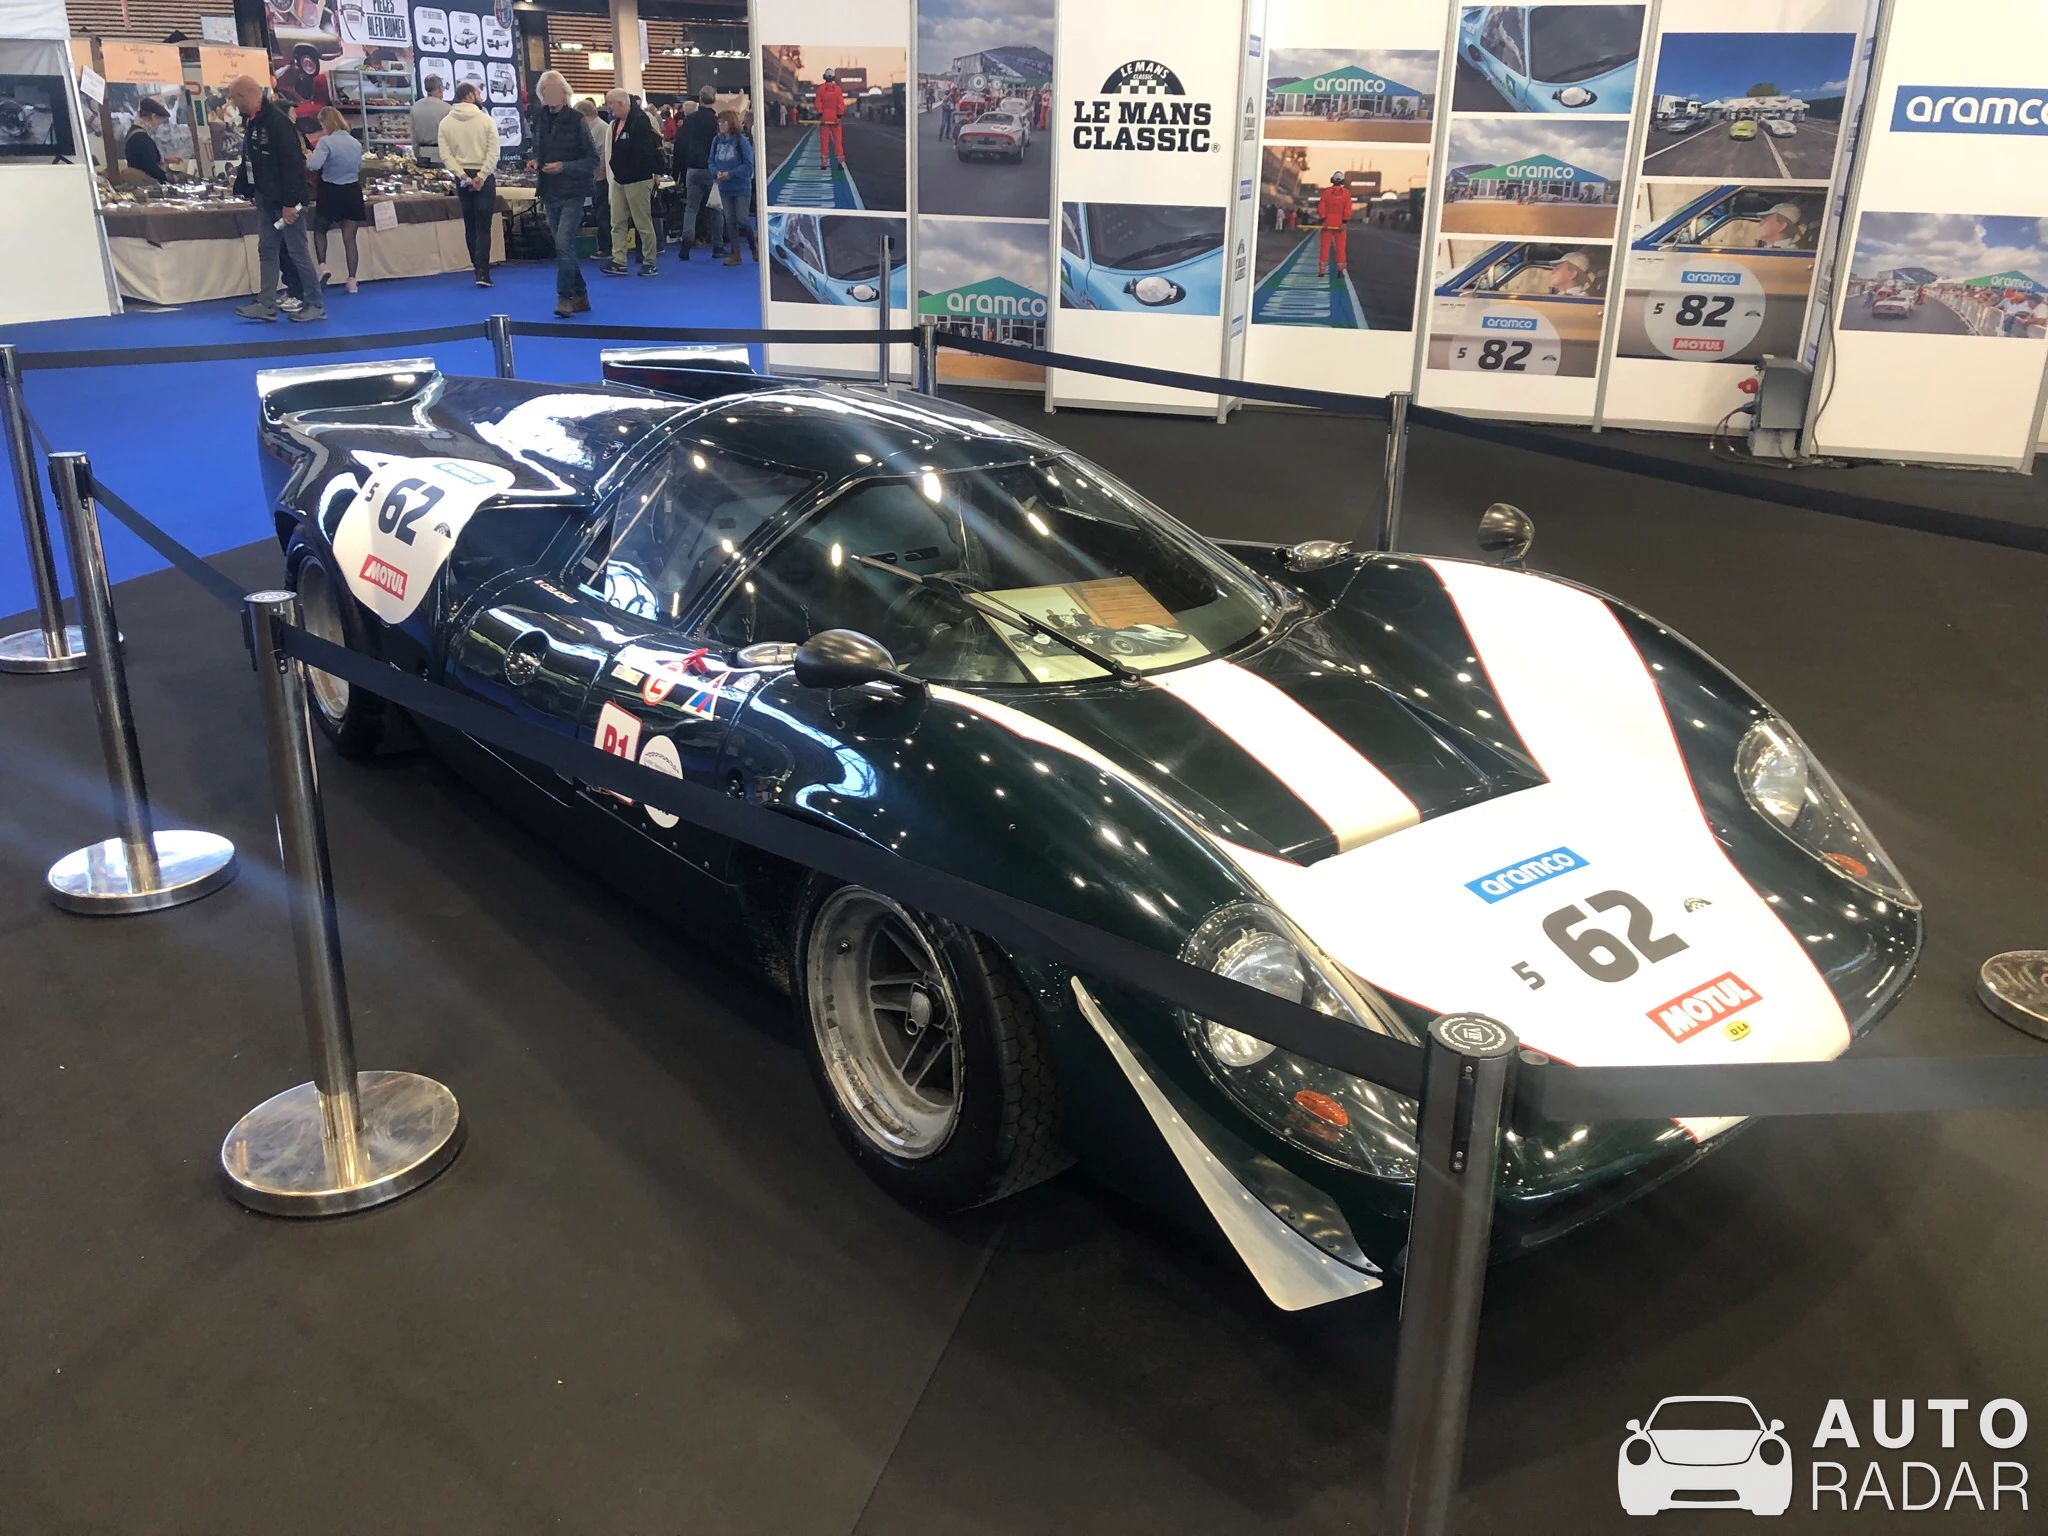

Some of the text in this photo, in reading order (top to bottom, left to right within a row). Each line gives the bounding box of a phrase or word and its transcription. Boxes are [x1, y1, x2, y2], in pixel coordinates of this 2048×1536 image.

[367, 16, 384, 37] ALFA
[384, 18, 406, 38] ROMEO
[1120, 61, 1170, 79] LE MANS
[1313, 77, 1386, 93] aramco
[1073, 100, 1212, 126] LE MANS
[1906, 95, 2048, 127] aramc
[1505, 164, 1575, 180] aramco
[1686, 272, 1736, 284] aramco
[1991, 275, 2034, 290] aramco
[946, 292, 1047, 317] aramco
[1653, 294, 1736, 328] 5 82
[1486, 318, 1533, 329] aramco
[1478, 339, 1533, 371] 82
[1675, 339, 1722, 351] MOTUL
[364, 477, 445, 547] 5 62
[363, 559, 405, 596] MOTUL
[1480, 852, 1576, 896] aramco
[1511, 889, 1691, 991] 5 62
[1657, 977, 1755, 1037] MOTUL
